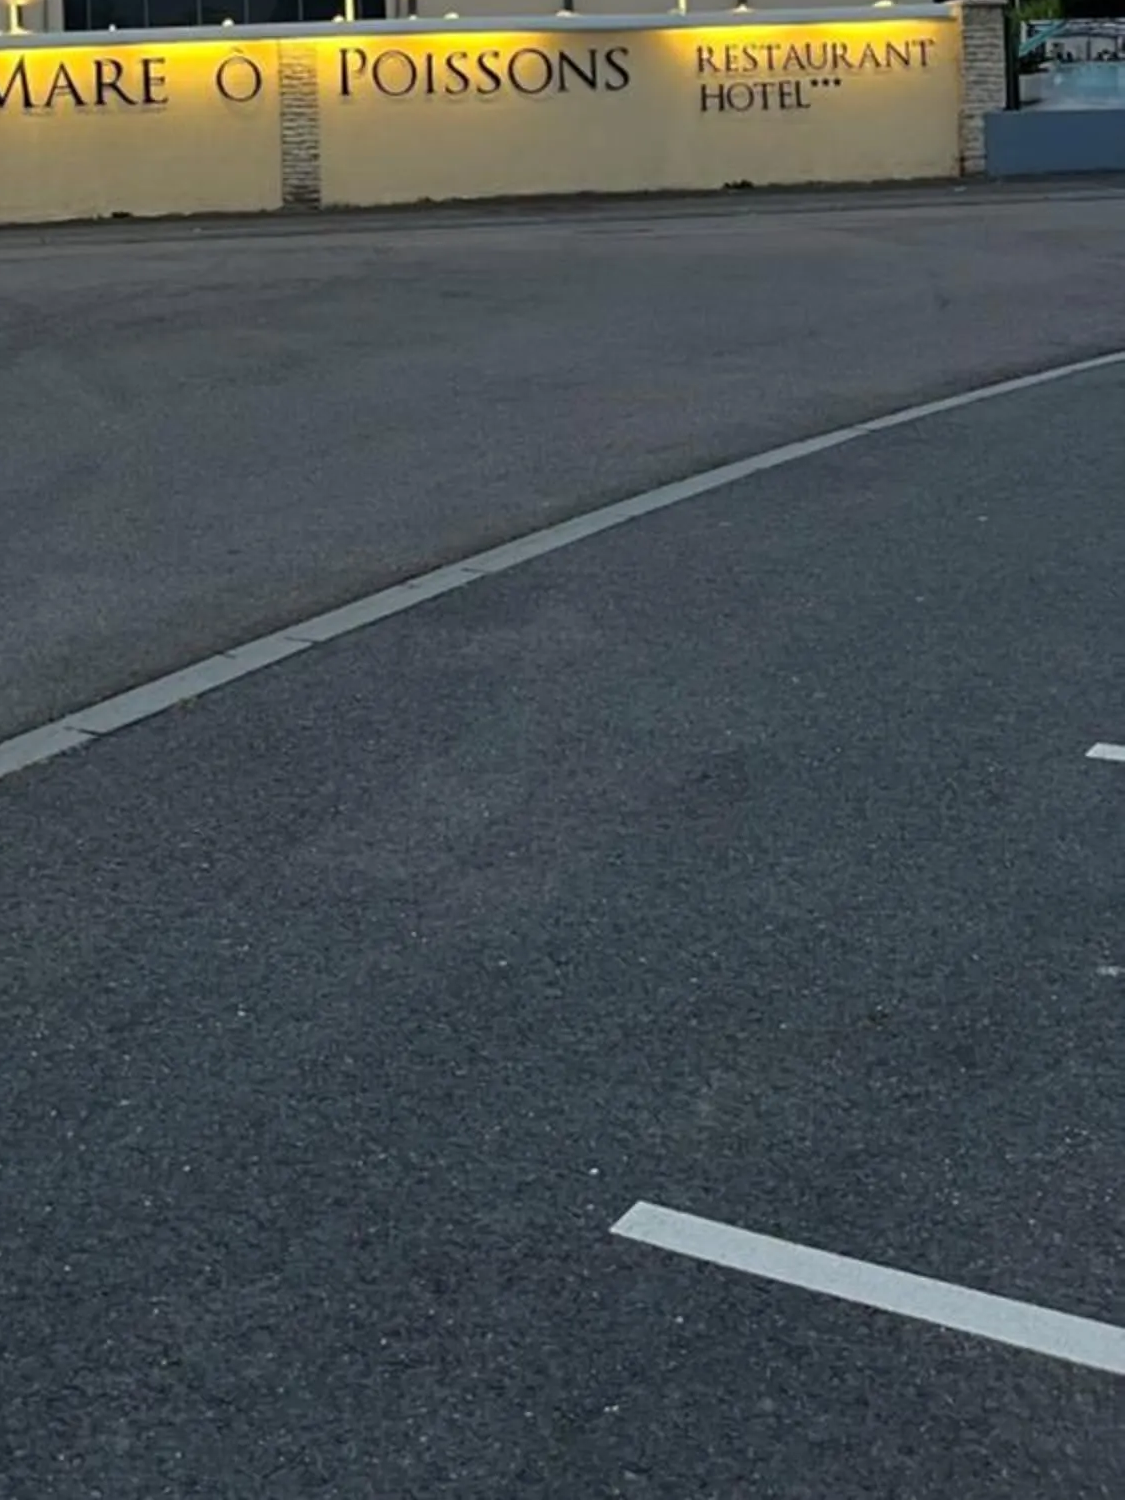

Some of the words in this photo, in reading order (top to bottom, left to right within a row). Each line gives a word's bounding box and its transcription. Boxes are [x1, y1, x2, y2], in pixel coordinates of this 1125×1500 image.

[339, 45, 631, 97] POISSONS
[696, 39, 935, 73] RESTAURANT
[700, 80, 811, 112] HOTEL
